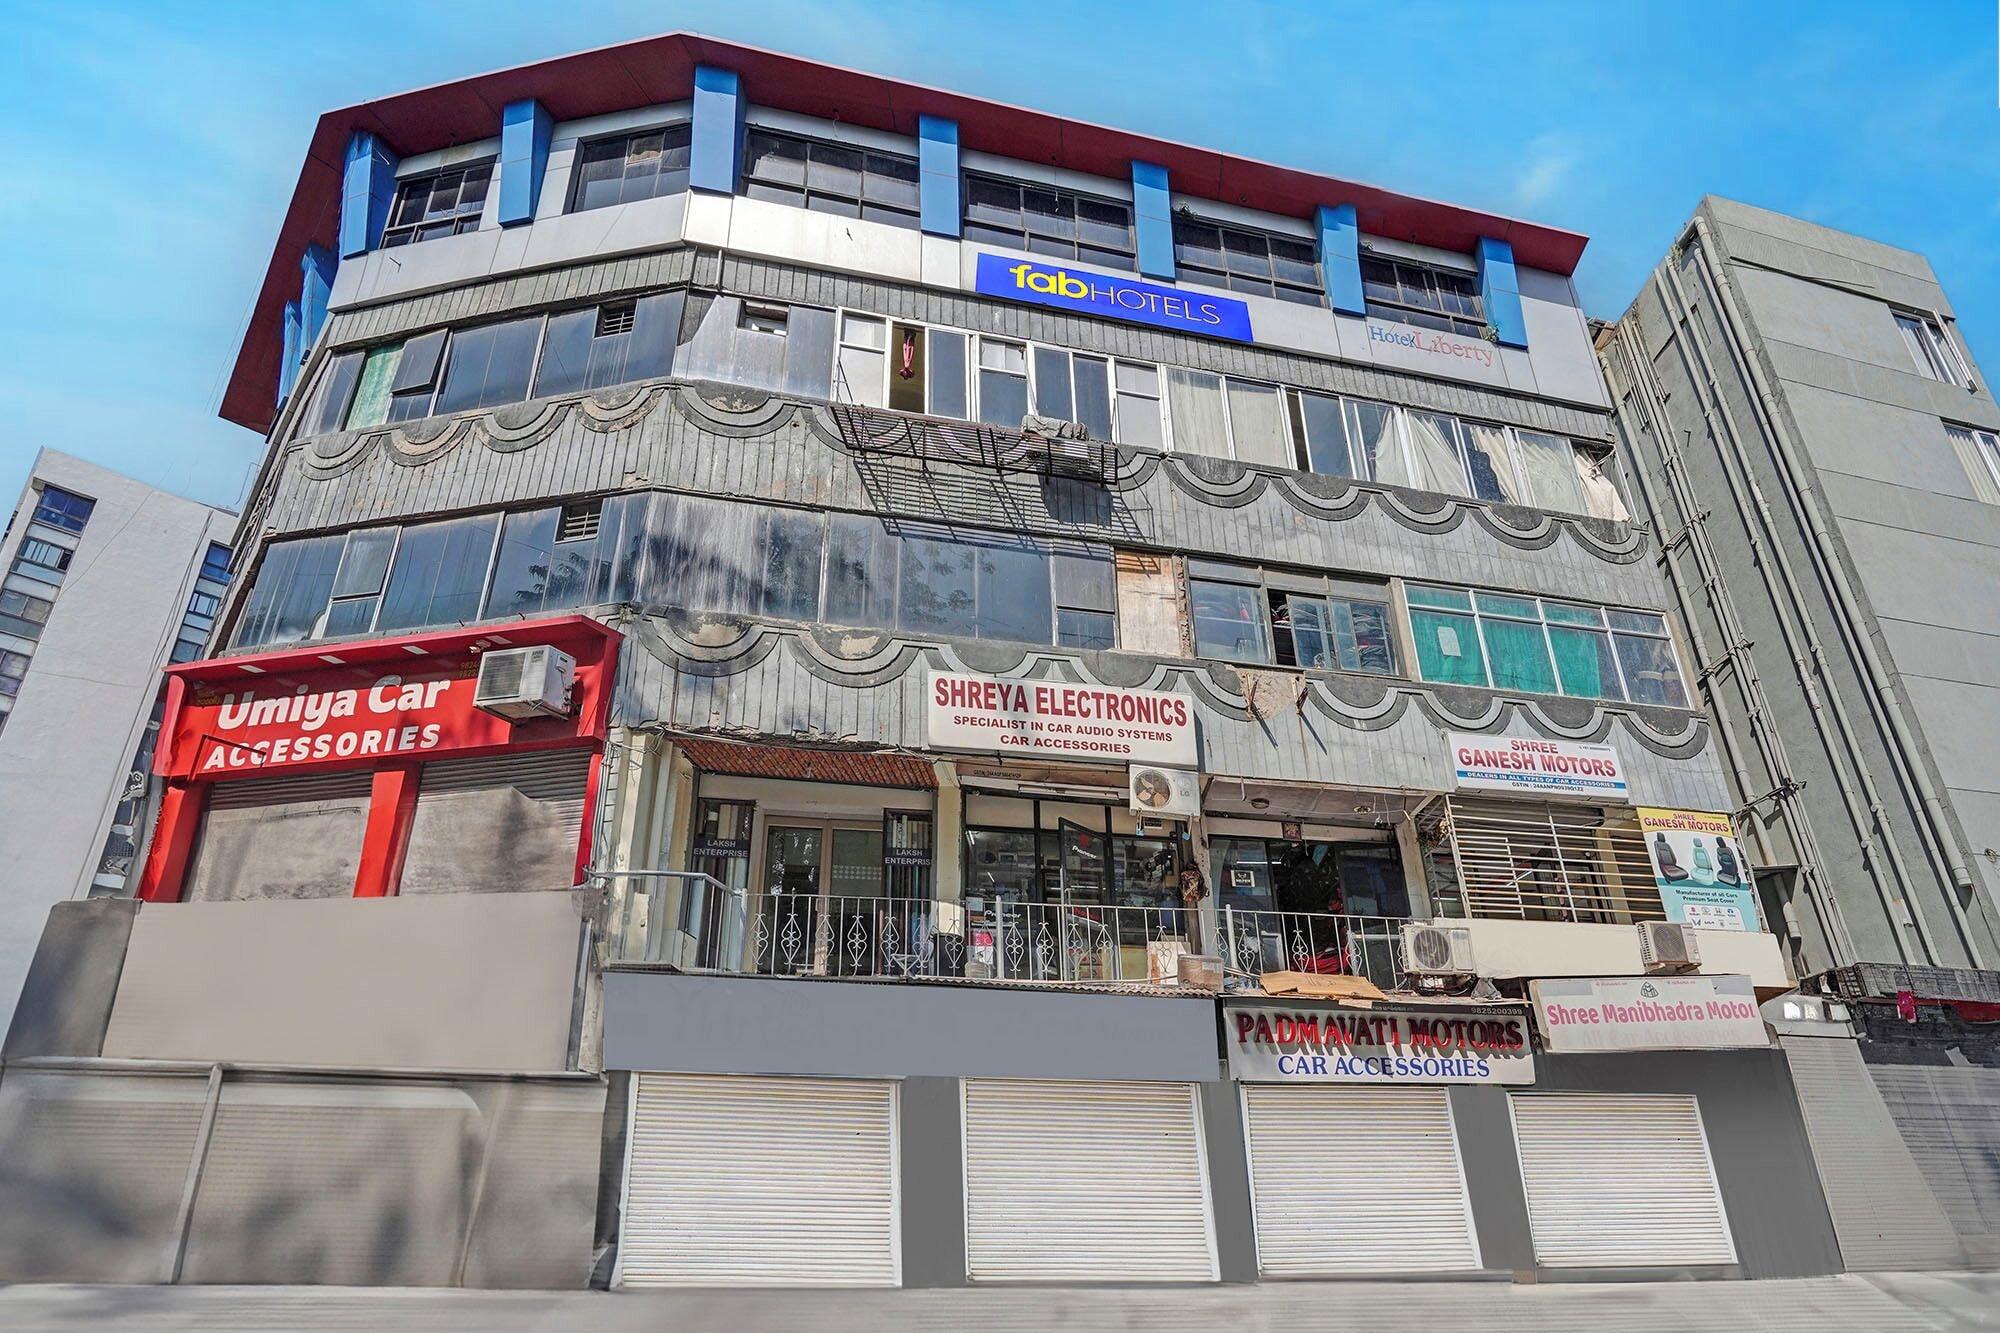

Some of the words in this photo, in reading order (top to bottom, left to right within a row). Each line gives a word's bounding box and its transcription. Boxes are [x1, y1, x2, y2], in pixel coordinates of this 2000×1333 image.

[1413, 330, 1494, 367] Liberty
[218, 684, 358, 731] Umiya
[368, 674, 451, 714] Car
[935, 678, 1029, 713] SHREYA
[1035, 687, 1187, 727] ELECTRONICS
[953, 716, 1027, 730] SPECIALIST
[1031, 721, 1044, 731] IN
[1047, 723, 1072, 734] CAR
[1076, 726, 1114, 737] AUDIO
[1117, 728, 1173, 742] SYSTEMS
[203, 723, 441, 770] ACCESSORIES
[1000, 735, 1029, 746] CAR
[1033, 738, 1131, 754] ACCESSORIES
[1510, 740, 1559, 754] SHREE
[1458, 747, 1536, 771] GANESH
[1540, 754, 1617, 778] MOTORS
[1467, 772, 1498, 780] DEALERS
[1571, 779, 1616, 788] ACCESSORIES
[1644, 817, 1686, 829] GANESH
[1688, 820, 1729, 833] MOTORS
[1673, 813, 1696, 821] SHREE
[694, 848, 749, 858] ENTERPRISE
[707, 840, 736, 848] LAKSH
[896, 849, 923, 857] LAKSH
[884, 857, 932, 866] ENTERPRIS
[1547, 1003, 1600, 1025] Shree
[1601, 1000, 1705, 1024] Manibhadra
[1235, 1012, 1400, 1046] PADMAVATI
[1407, 1017, 1525, 1050] MOTORS
[1278, 1055, 1327, 1075] CAR
[1334, 1056, 1491, 1077] ACCESSORIES
